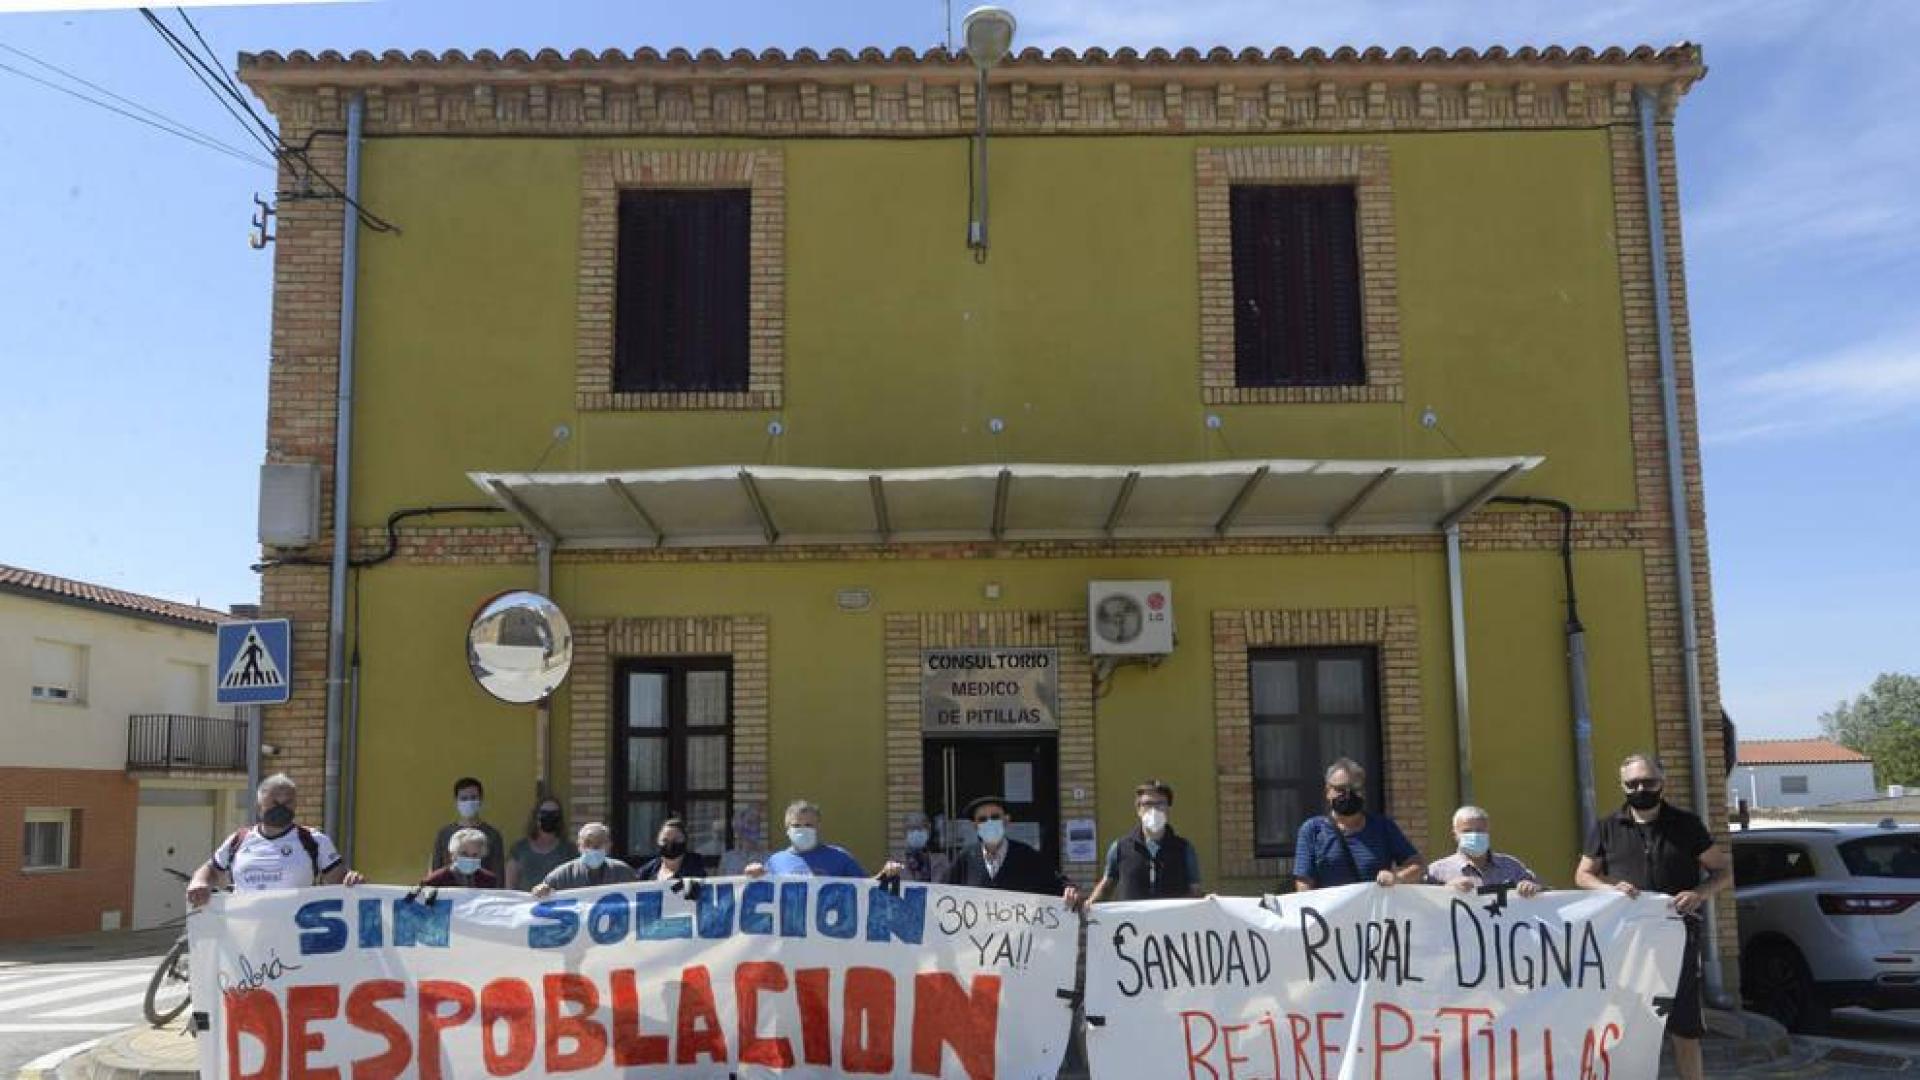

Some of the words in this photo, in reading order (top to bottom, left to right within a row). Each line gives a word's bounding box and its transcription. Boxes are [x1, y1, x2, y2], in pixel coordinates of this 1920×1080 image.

[1148, 611, 1164, 622] LG
[927, 653, 1049, 670] CONSULTORIO
[950, 681, 1019, 697] MEDICO
[937, 710, 961, 725] DE
[965, 708, 1041, 725] PITILLAS
[294, 897, 453, 955] SIN
[527, 880, 929, 949] SOLUCION
[936, 895, 979, 935] 30
[984, 899, 1061, 930] HORAS
[968, 931, 1034, 970] YA!!
[1112, 921, 1272, 997] SANIDAD
[1300, 906, 1425, 984] RURAL
[221, 960, 1004, 1080] DESPOBLACION
